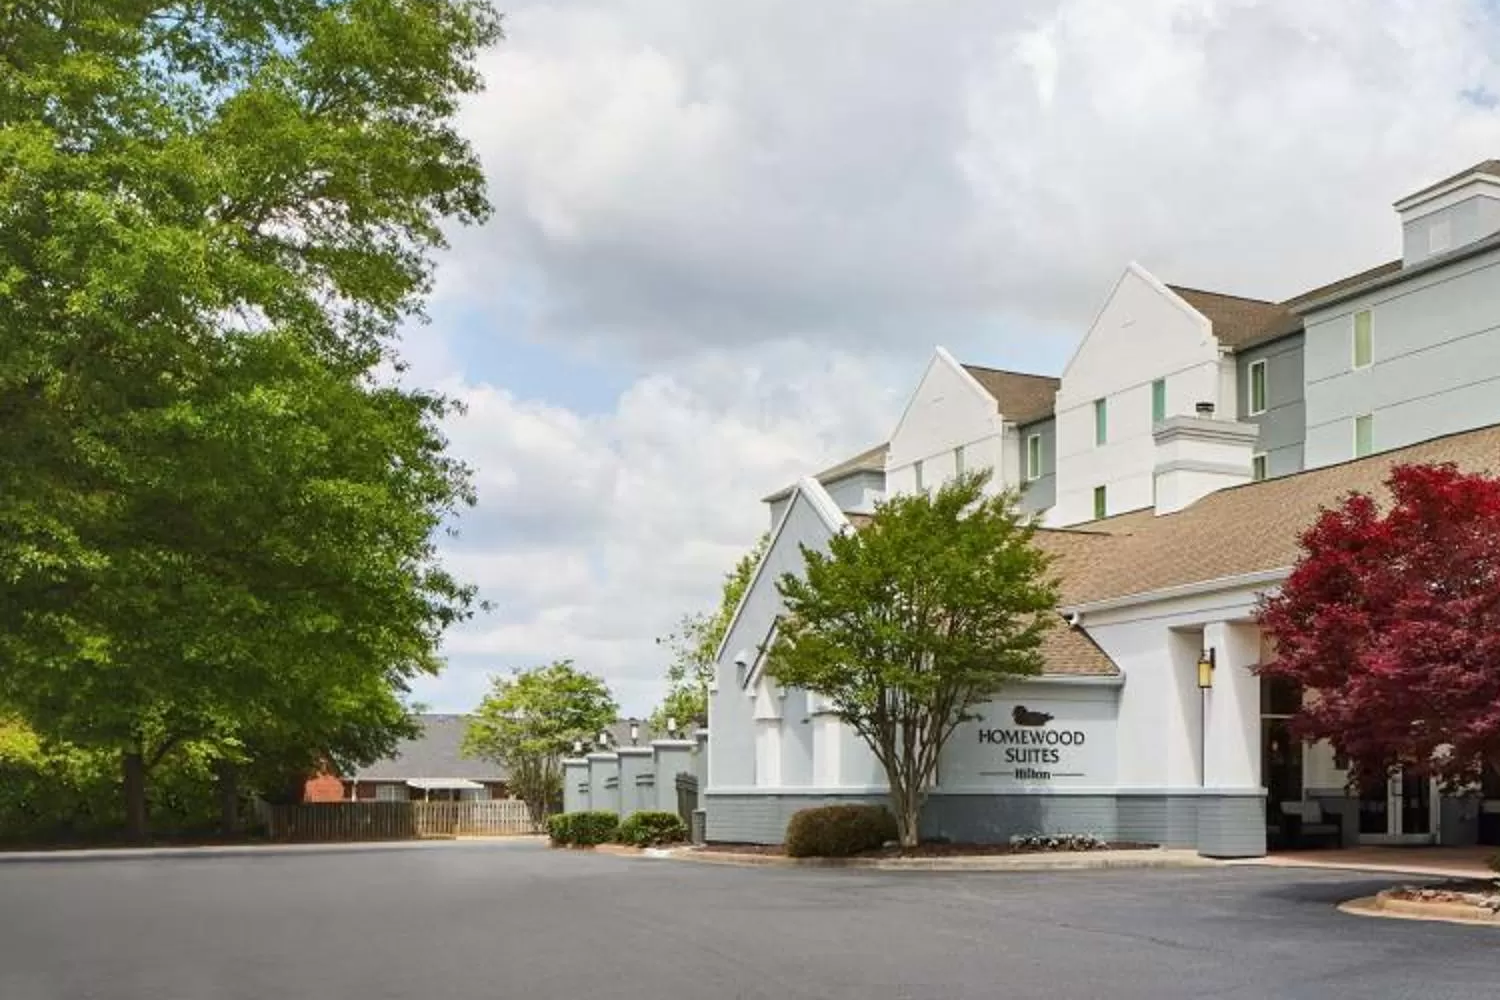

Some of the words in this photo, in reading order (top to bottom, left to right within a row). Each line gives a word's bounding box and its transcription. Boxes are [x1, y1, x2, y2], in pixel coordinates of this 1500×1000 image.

[978, 729, 1085, 746] HOMEWOOD
[1004, 747, 1060, 764] SUITES
[1014, 767, 1051, 780] Hilton
